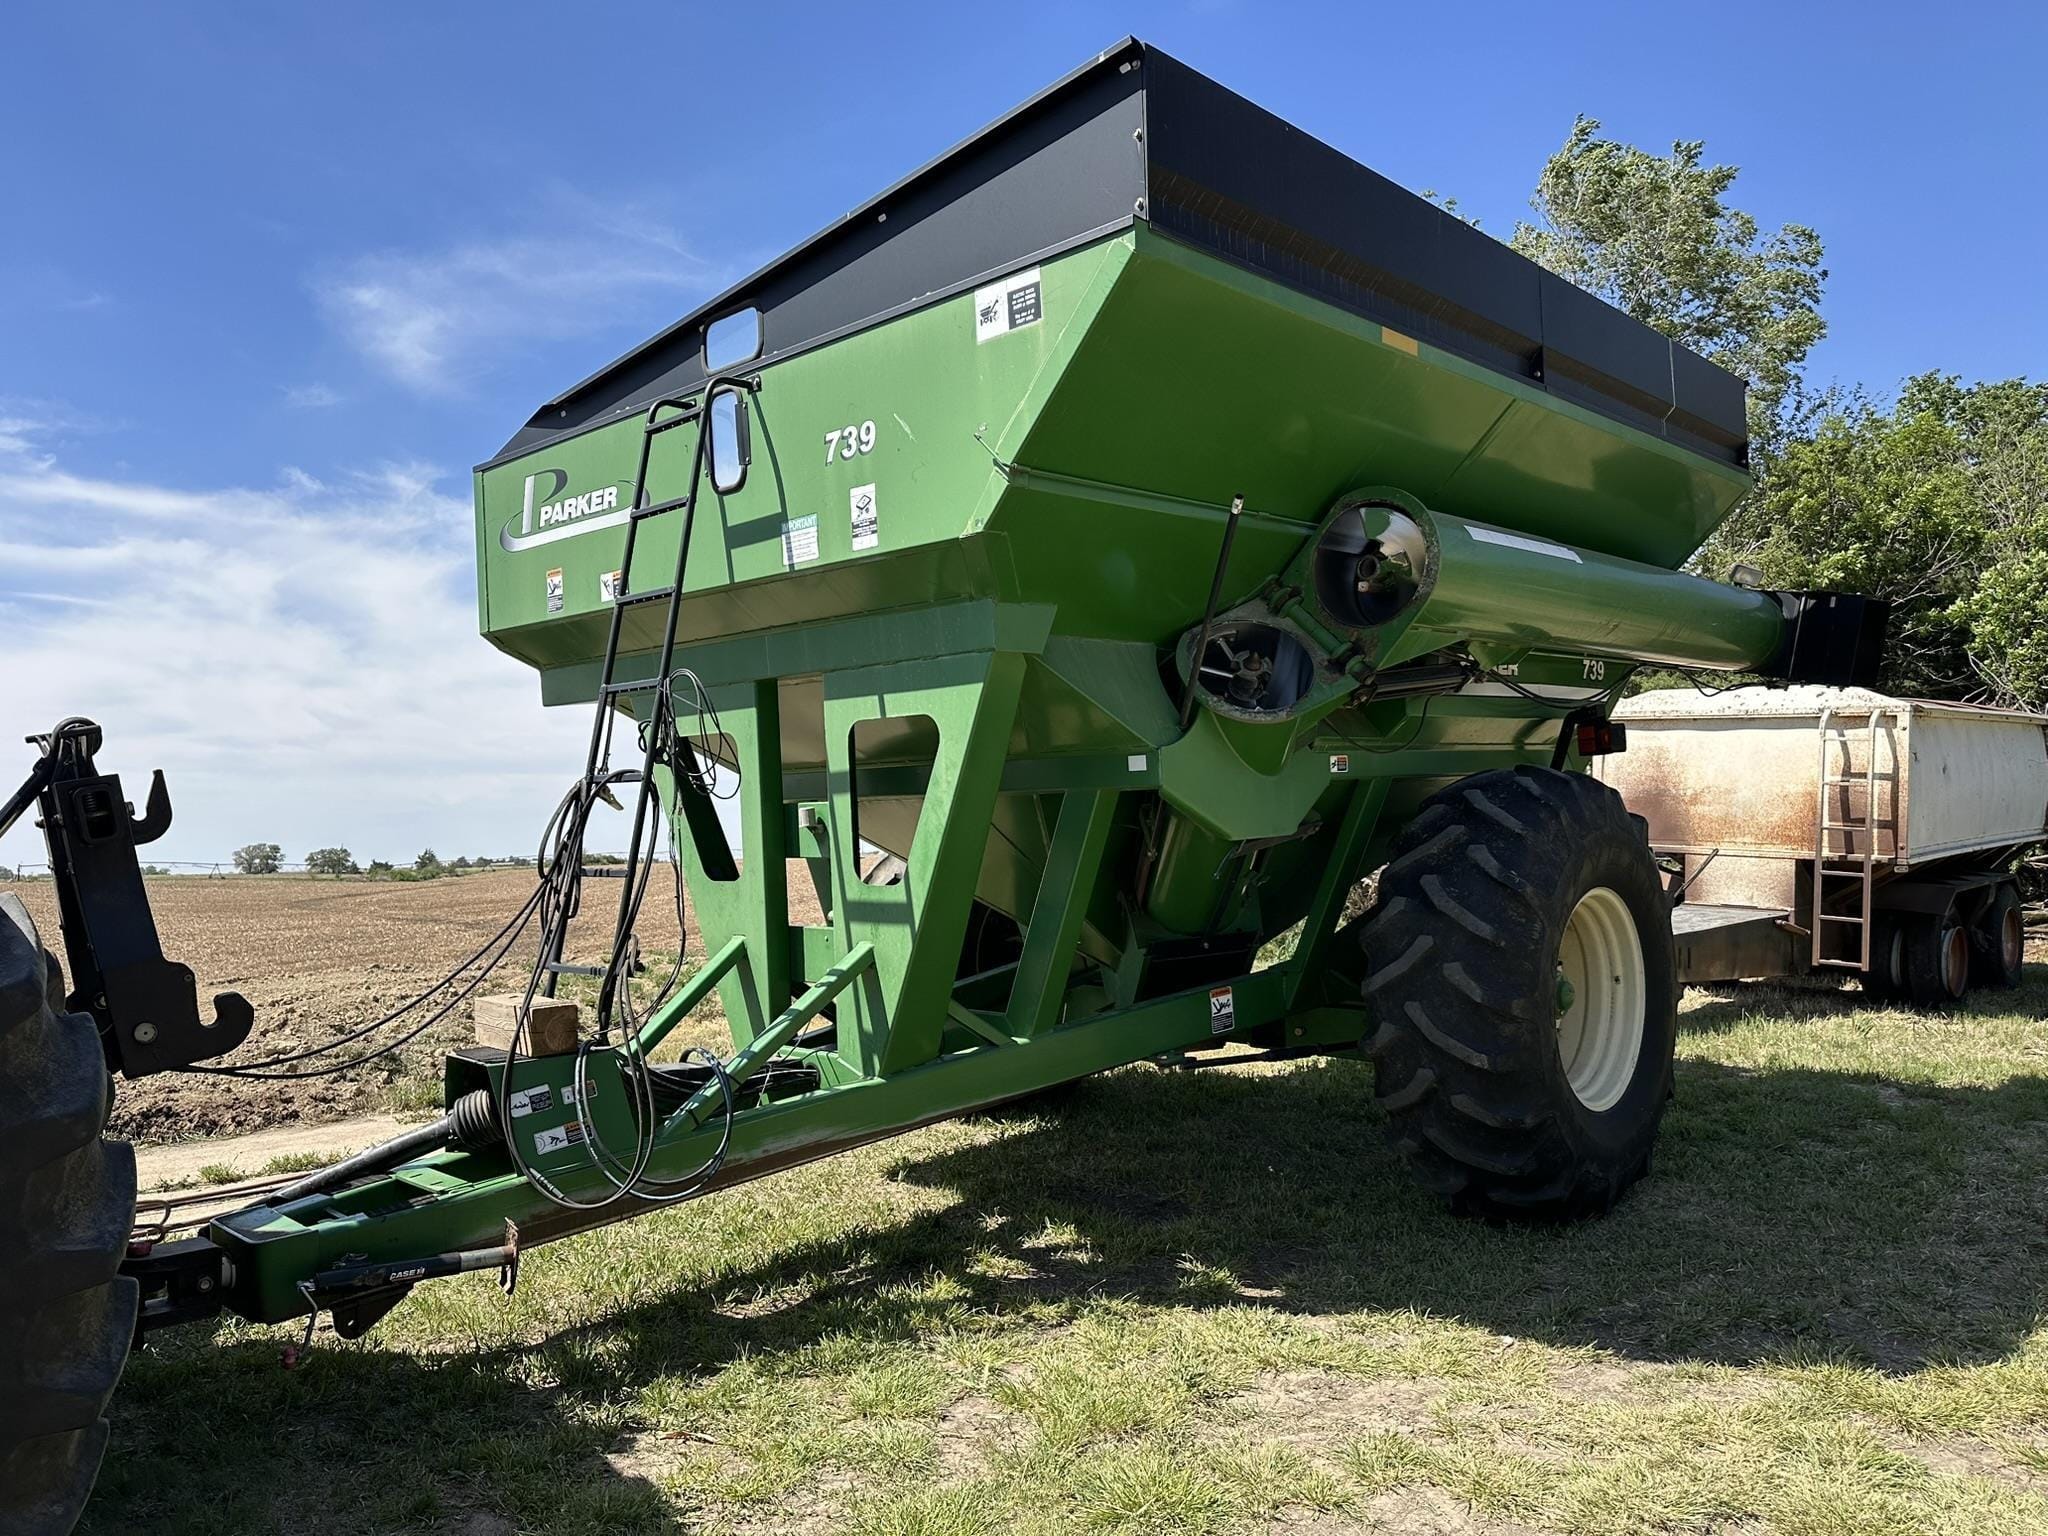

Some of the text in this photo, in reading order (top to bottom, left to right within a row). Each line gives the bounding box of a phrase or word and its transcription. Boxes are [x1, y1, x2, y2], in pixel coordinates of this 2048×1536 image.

[824, 420, 876, 466] 739
[539, 485, 618, 529] PARKER
[1582, 659, 1605, 681] 739
[390, 1269, 416, 1280] CASE
